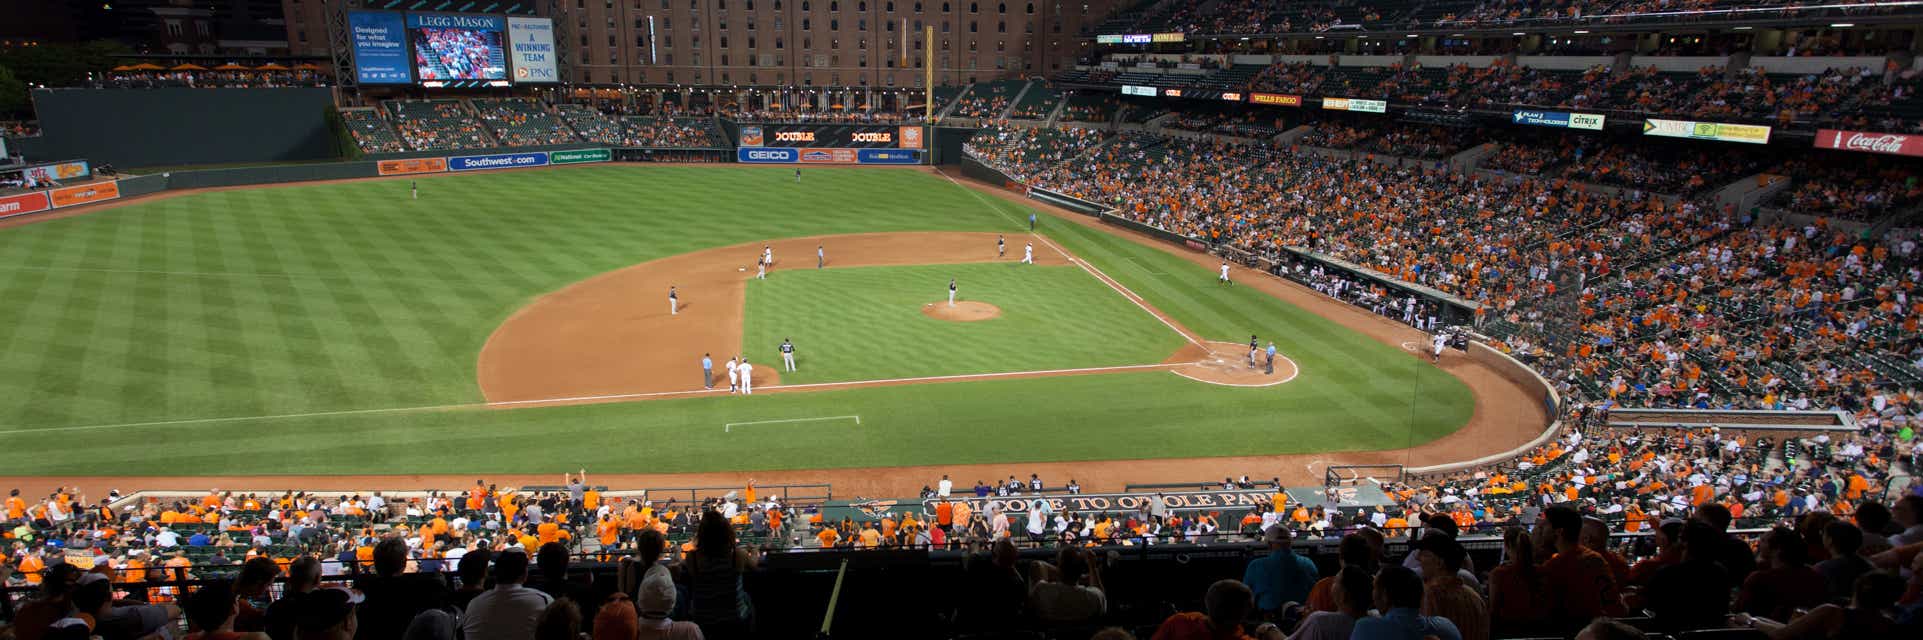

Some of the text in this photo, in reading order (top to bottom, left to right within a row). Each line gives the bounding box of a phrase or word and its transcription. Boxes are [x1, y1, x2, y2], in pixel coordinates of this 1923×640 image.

[419, 15, 494, 28] LEGG MASON
[355, 26, 388, 34] Designed
[529, 33, 536, 41] A
[514, 43, 551, 52] WINNING
[522, 53, 545, 62] TEAM
[530, 68, 553, 78] PNC
[1254, 95, 1296, 104] WELLS FARGO
[775, 131, 815, 141] DOUBLE
[851, 132, 891, 142] DOUBLE
[1846, 132, 1906, 152] Coca-Cola
[748, 150, 790, 160] GEICO
[1072, 496, 1110, 510] TO
[1117, 494, 1217, 509] OROLE
